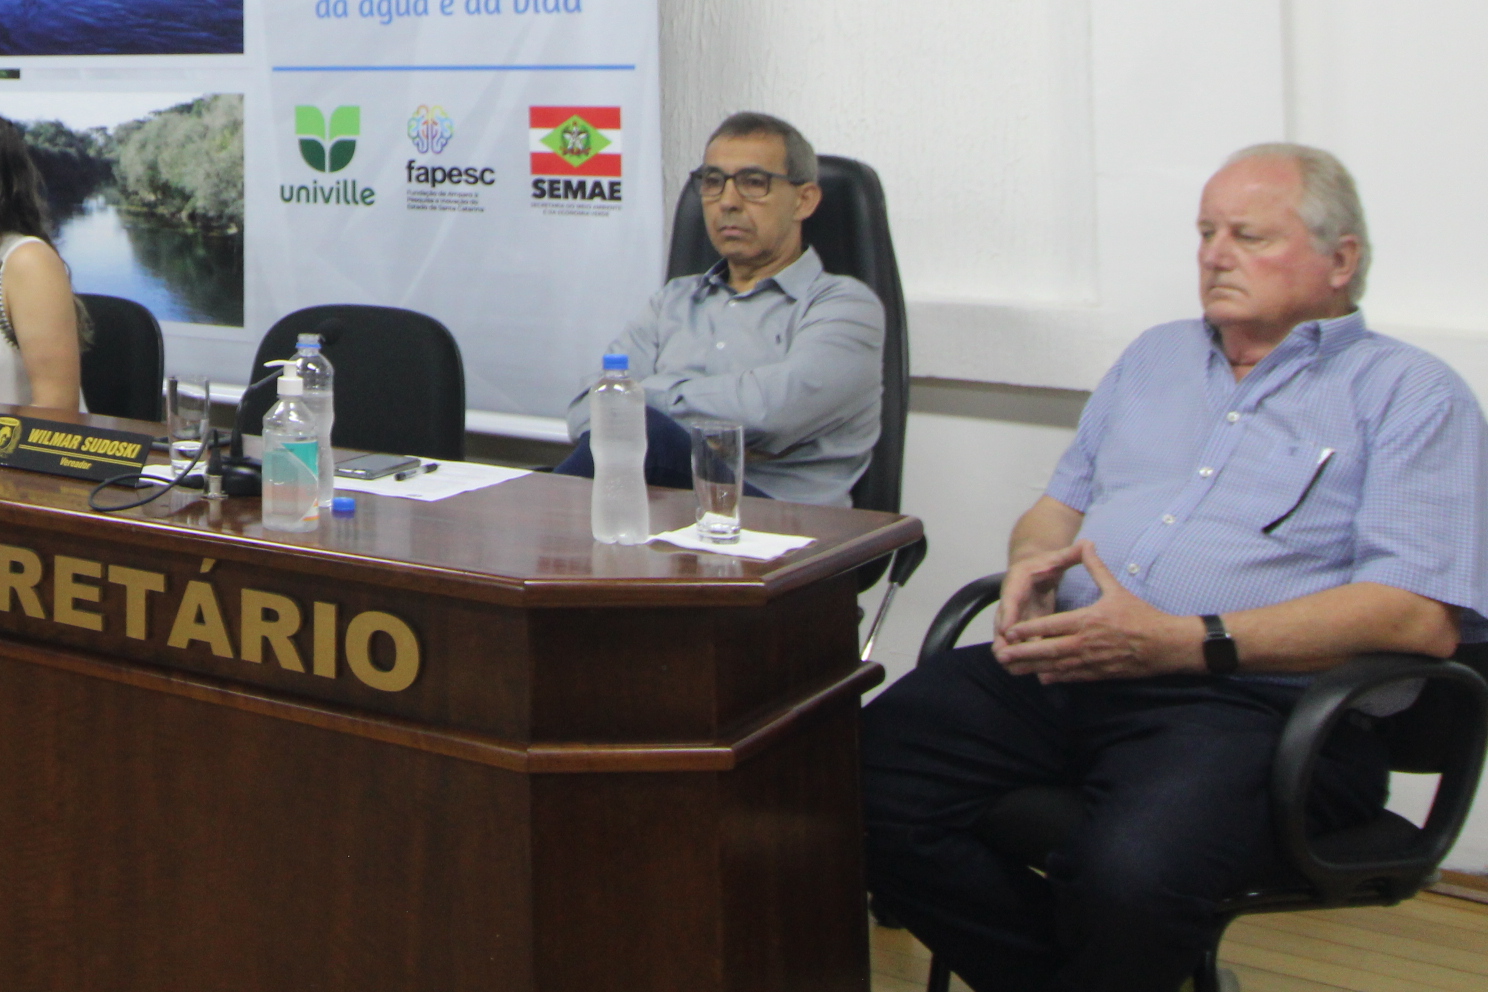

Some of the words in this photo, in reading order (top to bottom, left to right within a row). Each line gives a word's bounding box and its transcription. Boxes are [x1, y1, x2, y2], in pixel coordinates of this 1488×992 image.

[406, 160, 496, 187] fapesc
[280, 179, 375, 206] univille
[531, 178, 622, 201] SEMAE
[27, 428, 83, 451] WILMAR
[81, 436, 142, 459] SUDOSKI
[59, 457, 92, 470] Vereador
